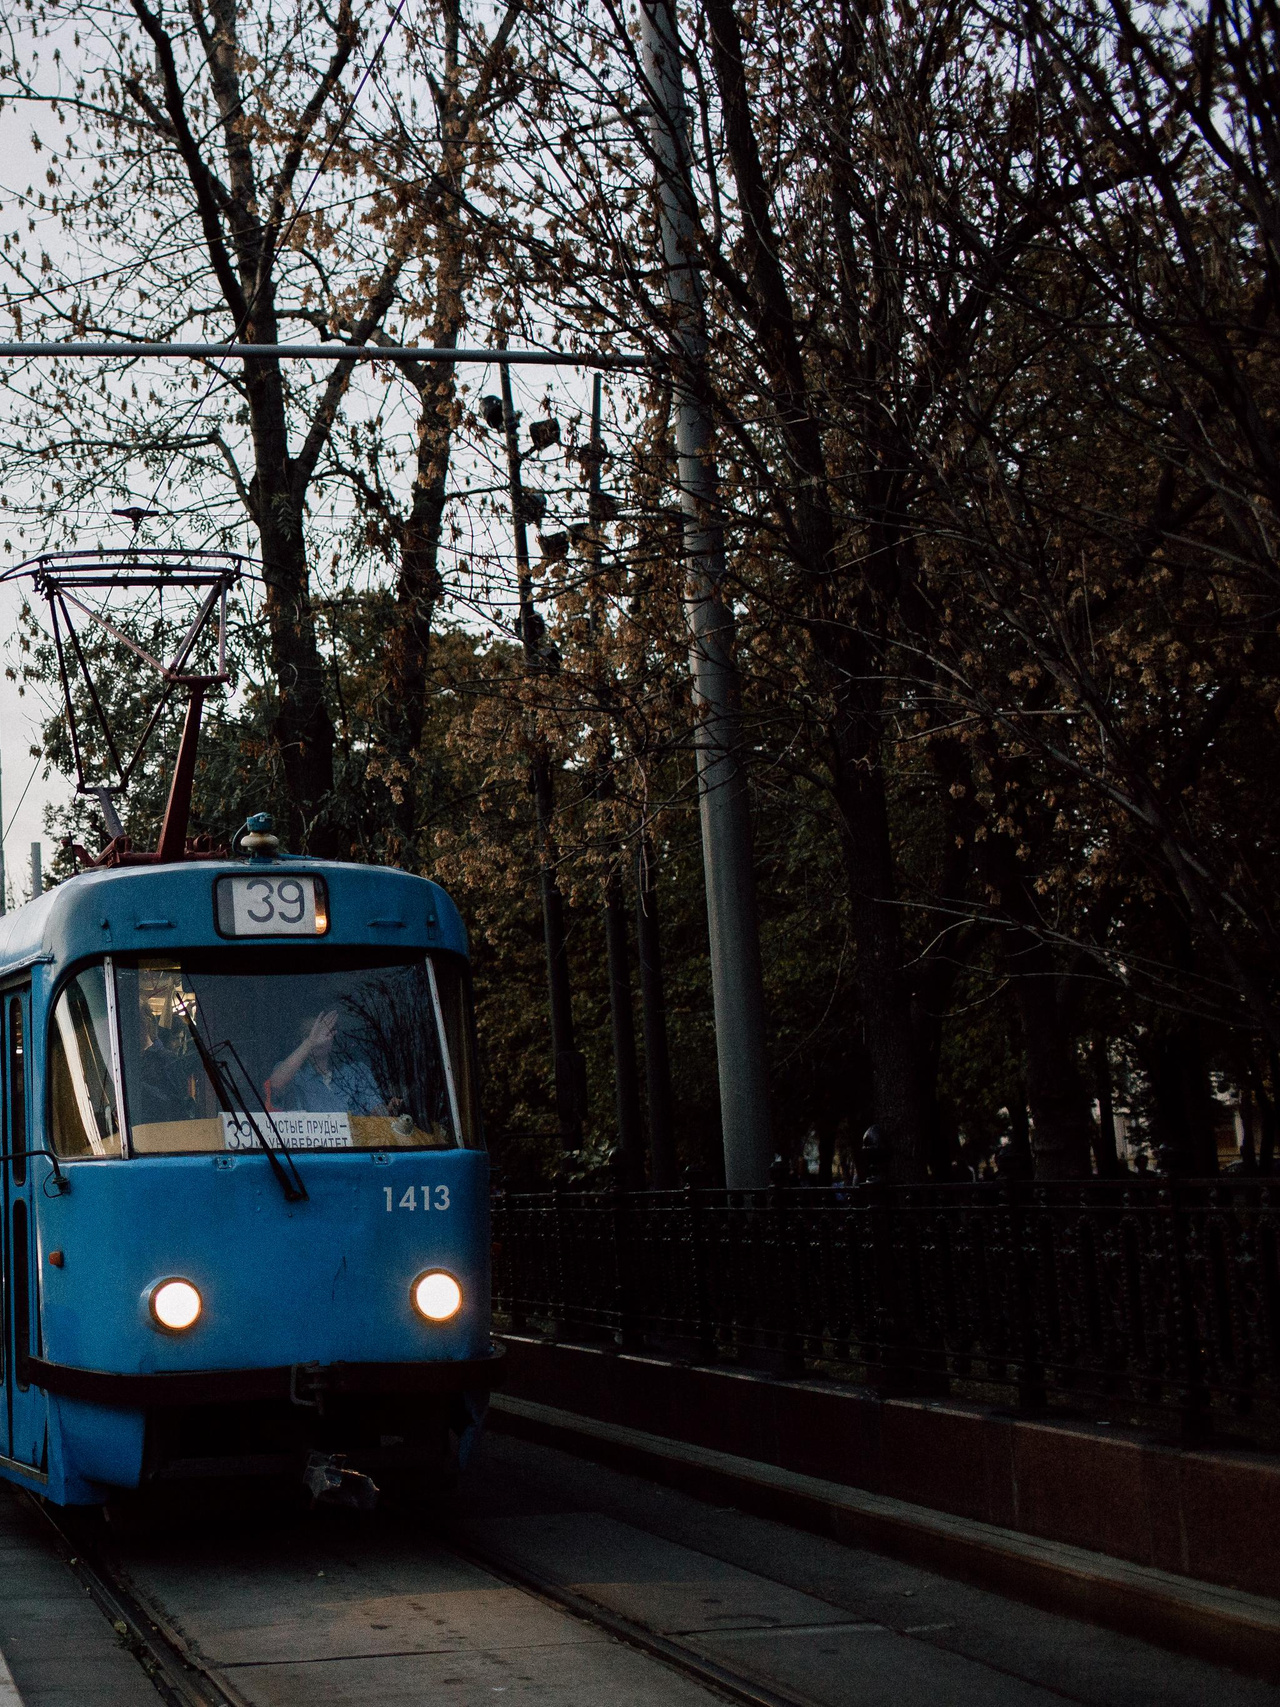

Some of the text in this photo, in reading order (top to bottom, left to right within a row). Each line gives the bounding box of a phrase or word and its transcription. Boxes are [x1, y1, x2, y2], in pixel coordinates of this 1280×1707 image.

[246, 880, 305, 924] 39
[226, 1120, 254, 1149] 39
[383, 1184, 451, 1212] 1413
